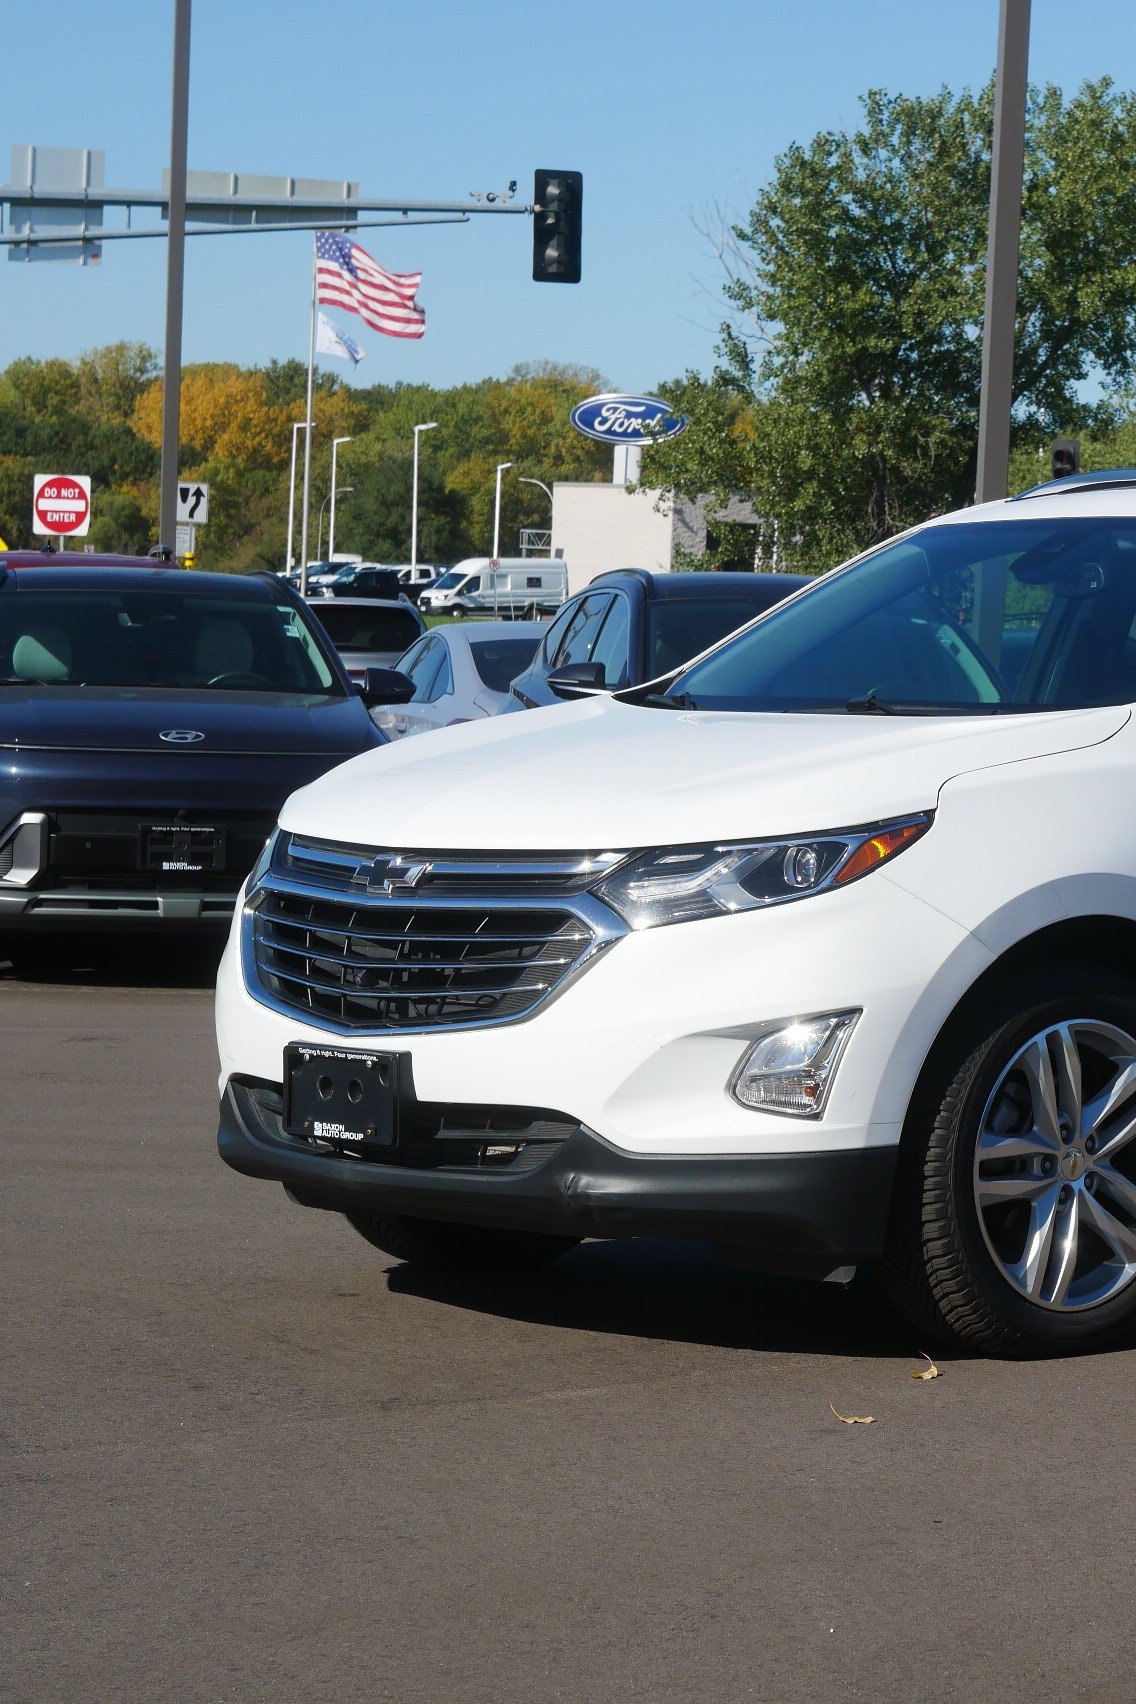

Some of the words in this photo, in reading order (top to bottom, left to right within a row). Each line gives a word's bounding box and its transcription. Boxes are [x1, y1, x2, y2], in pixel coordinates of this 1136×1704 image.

[44, 487, 57, 497] DO
[61, 488, 79, 498] NOT
[47, 512, 76, 522] ENTER
[322, 1122, 345, 1131] SAXON
[322, 1130, 340, 1138] AUTO
[340, 1131, 364, 1140] GROUP
